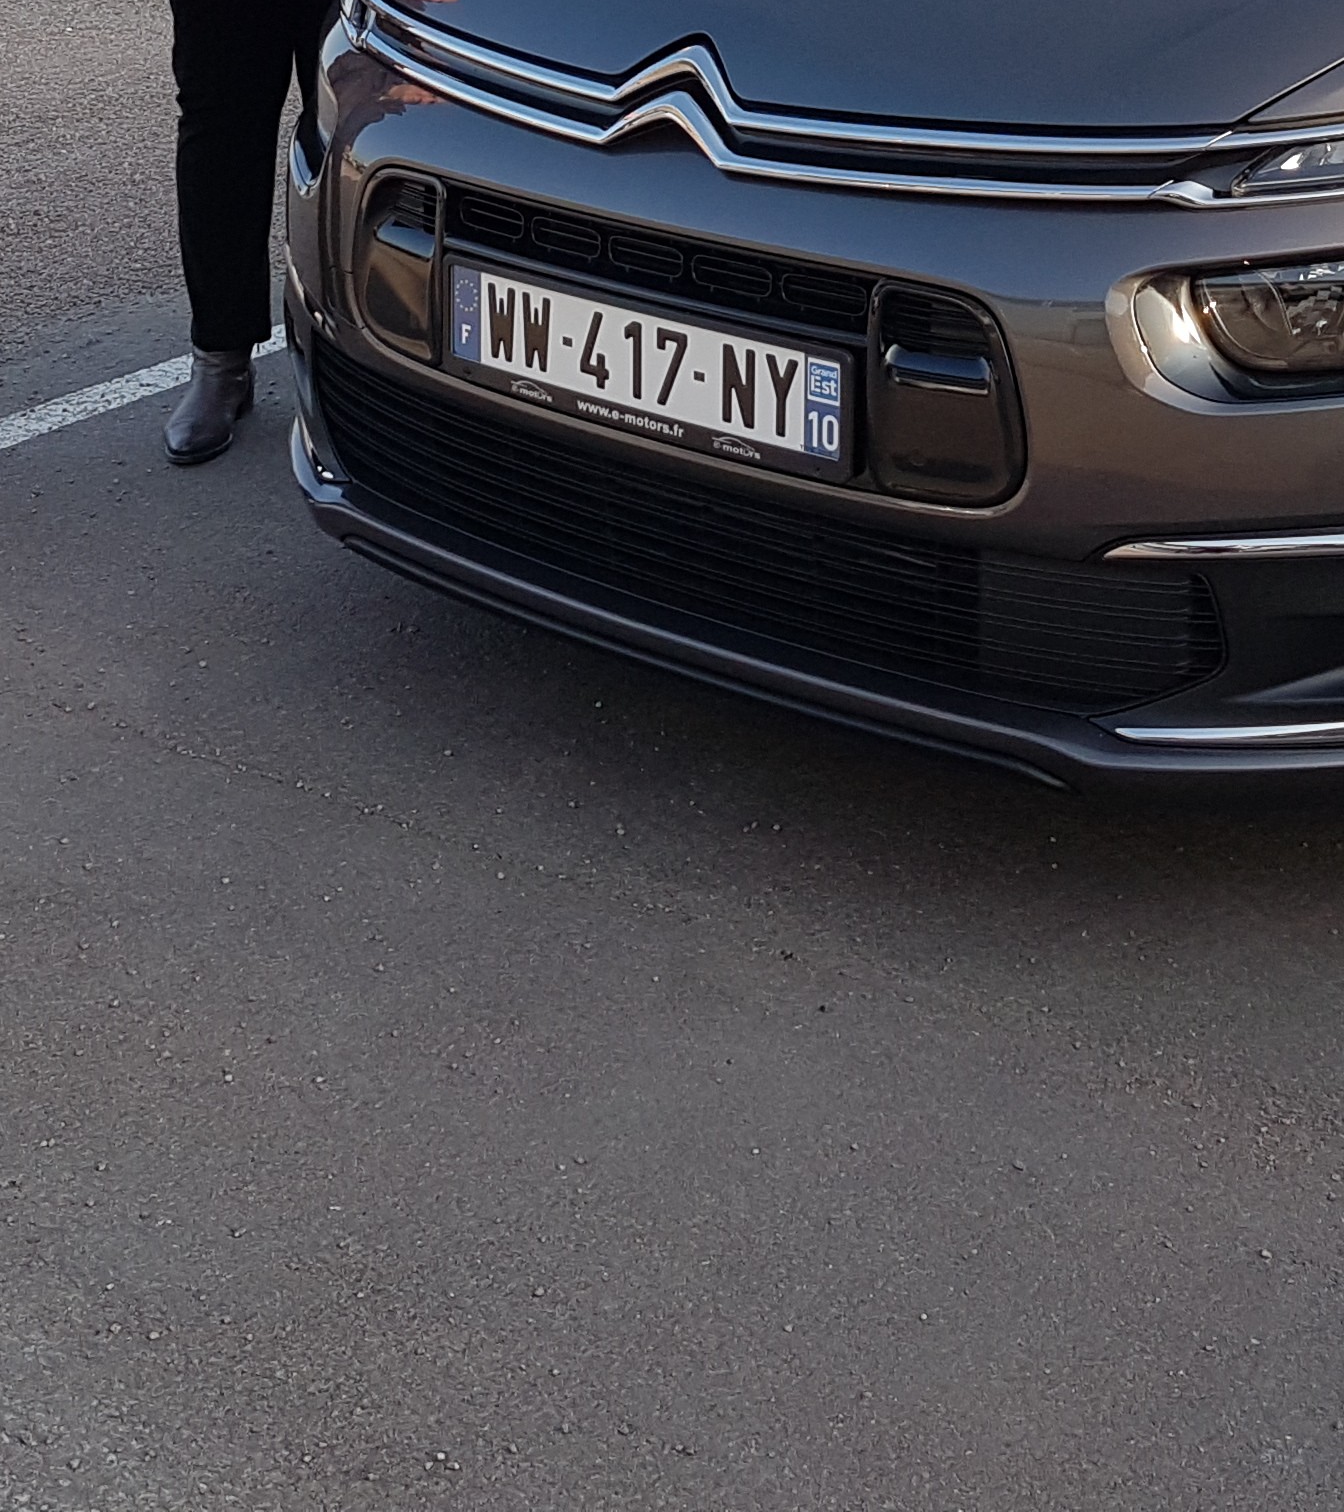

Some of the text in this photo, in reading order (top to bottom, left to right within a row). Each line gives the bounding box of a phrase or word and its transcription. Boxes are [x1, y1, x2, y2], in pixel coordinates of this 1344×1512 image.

[461, 323, 472, 345] F
[487, 281, 800, 439] WW-417-NY
[810, 365, 838, 380] Grand
[810, 374, 838, 397] Est
[577, 399, 685, 438] www.e-motors.fr
[808, 410, 840, 452] 10
